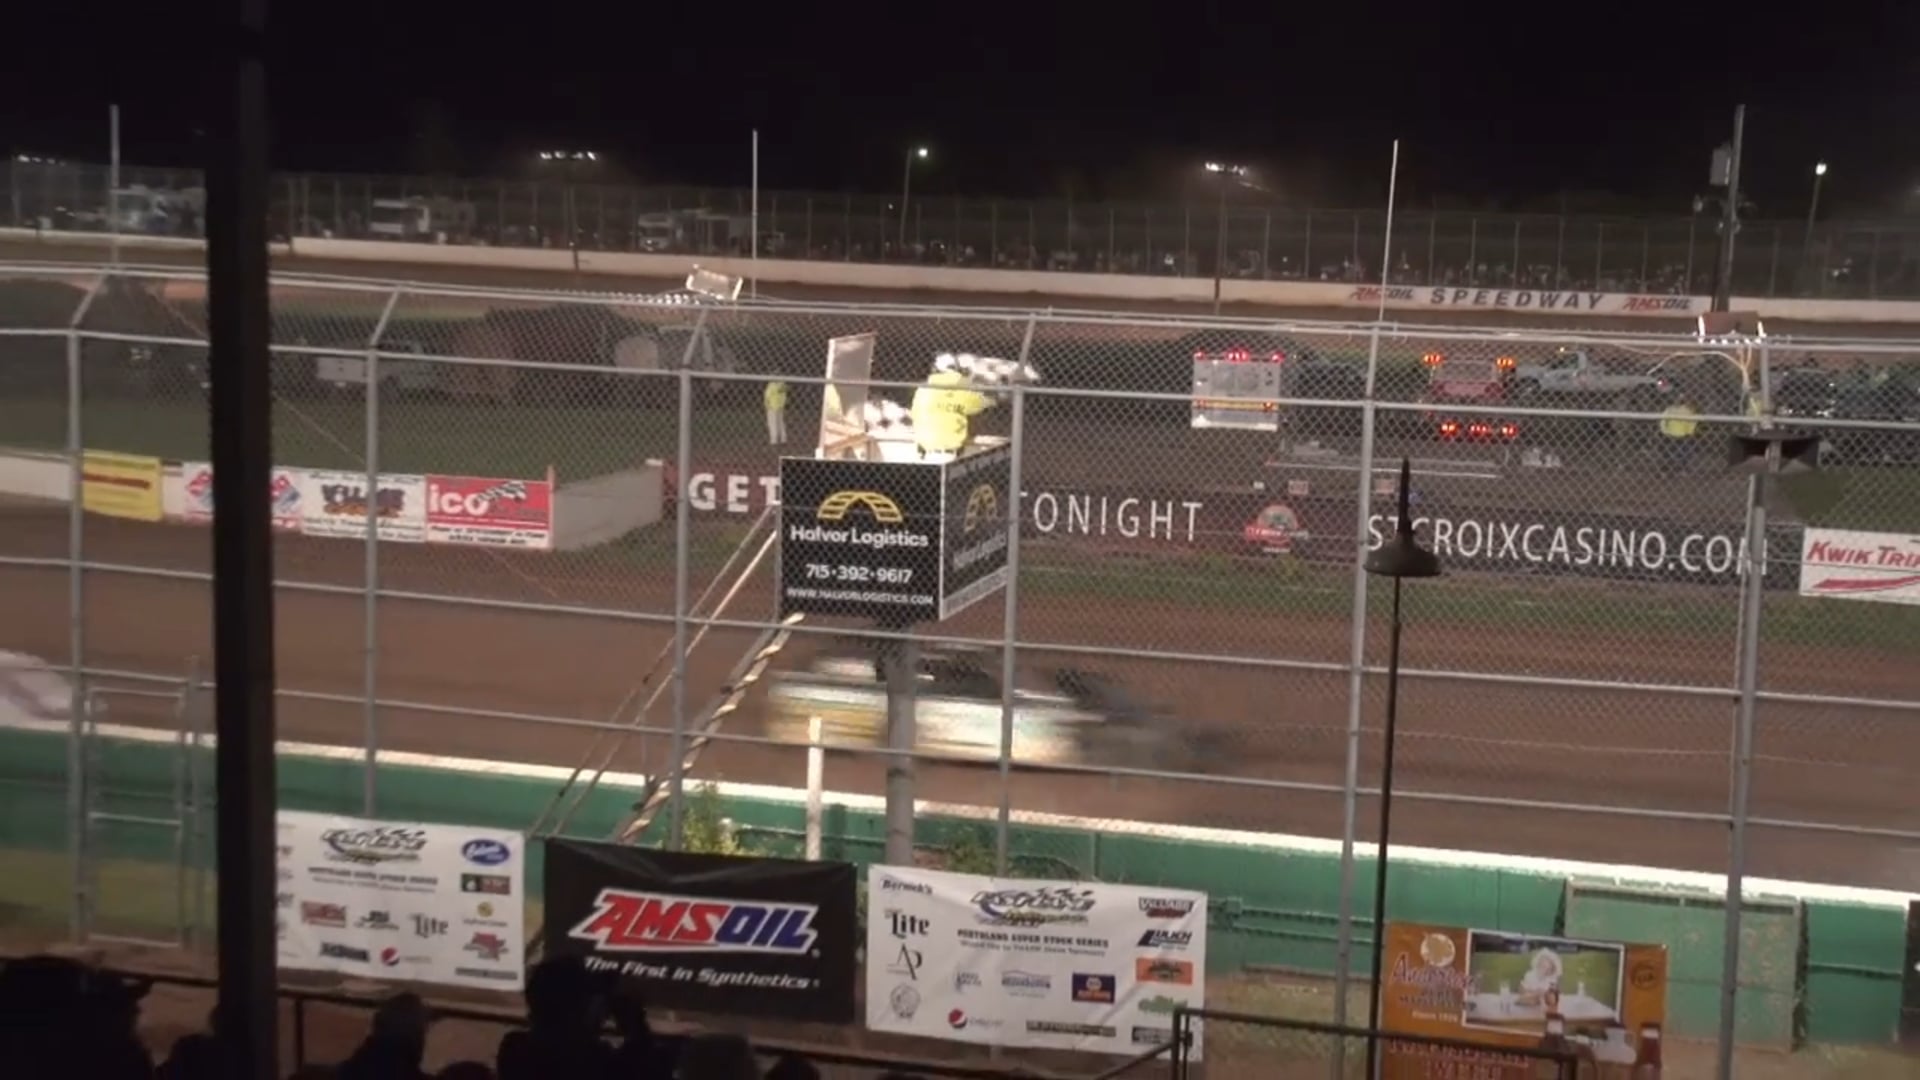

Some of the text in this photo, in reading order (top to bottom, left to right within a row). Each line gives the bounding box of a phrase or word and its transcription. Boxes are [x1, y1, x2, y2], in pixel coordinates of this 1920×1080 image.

[1430, 288, 1602, 310] SPEEDWAY
[1622, 296, 1692, 312] AMSOIL
[688, 472, 1203, 541] GET ONIGHT
[790, 525, 929, 549] Halvor Logistics
[567, 887, 820, 955] AMSOIL
[888, 909, 931, 939] Lite
[620, 960, 667, 979] First
[696, 968, 810, 989] Synthetics
